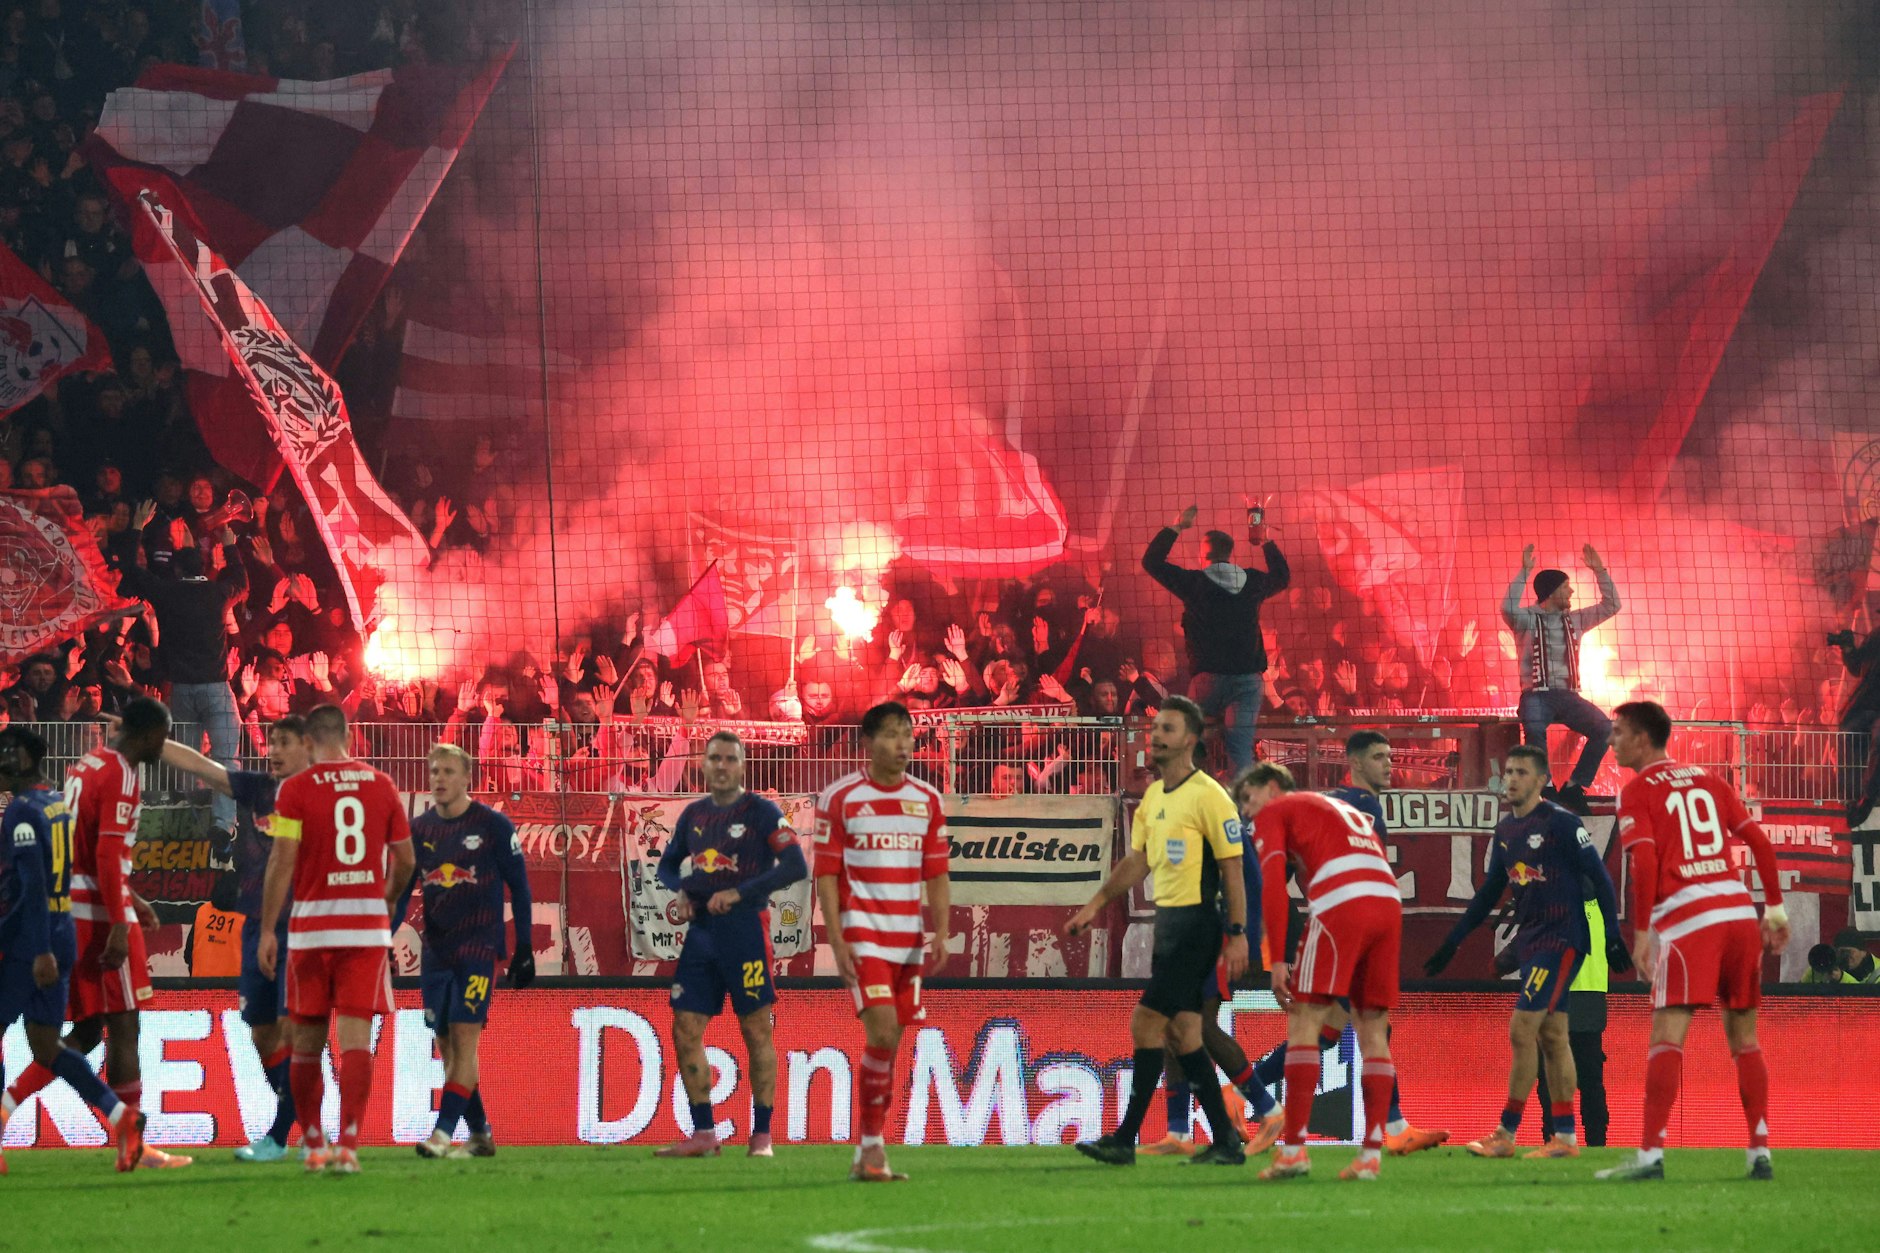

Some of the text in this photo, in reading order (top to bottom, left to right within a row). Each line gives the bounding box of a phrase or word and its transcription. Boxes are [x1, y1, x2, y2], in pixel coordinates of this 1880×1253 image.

[323, 771, 340, 783] FC
[339, 770, 376, 782] UNION
[1655, 770, 1672, 782] FC
[1378, 793, 1499, 829] UGEND
[1665, 788, 1724, 860] 19
[334, 795, 367, 866] 8
[508, 801, 615, 864] mos!
[872, 831, 923, 850] raisin
[131, 840, 211, 870] GEGEN
[1679, 858, 1729, 878] HABERER
[327, 869, 376, 887] KHEDIRA
[205, 913, 235, 934] 291
[652, 929, 803, 949] Mit R doof
[743, 960, 765, 988] 22
[1525, 966, 1550, 992] 14
[464, 974, 490, 1001] 24
[571, 1005, 854, 1144] Den
